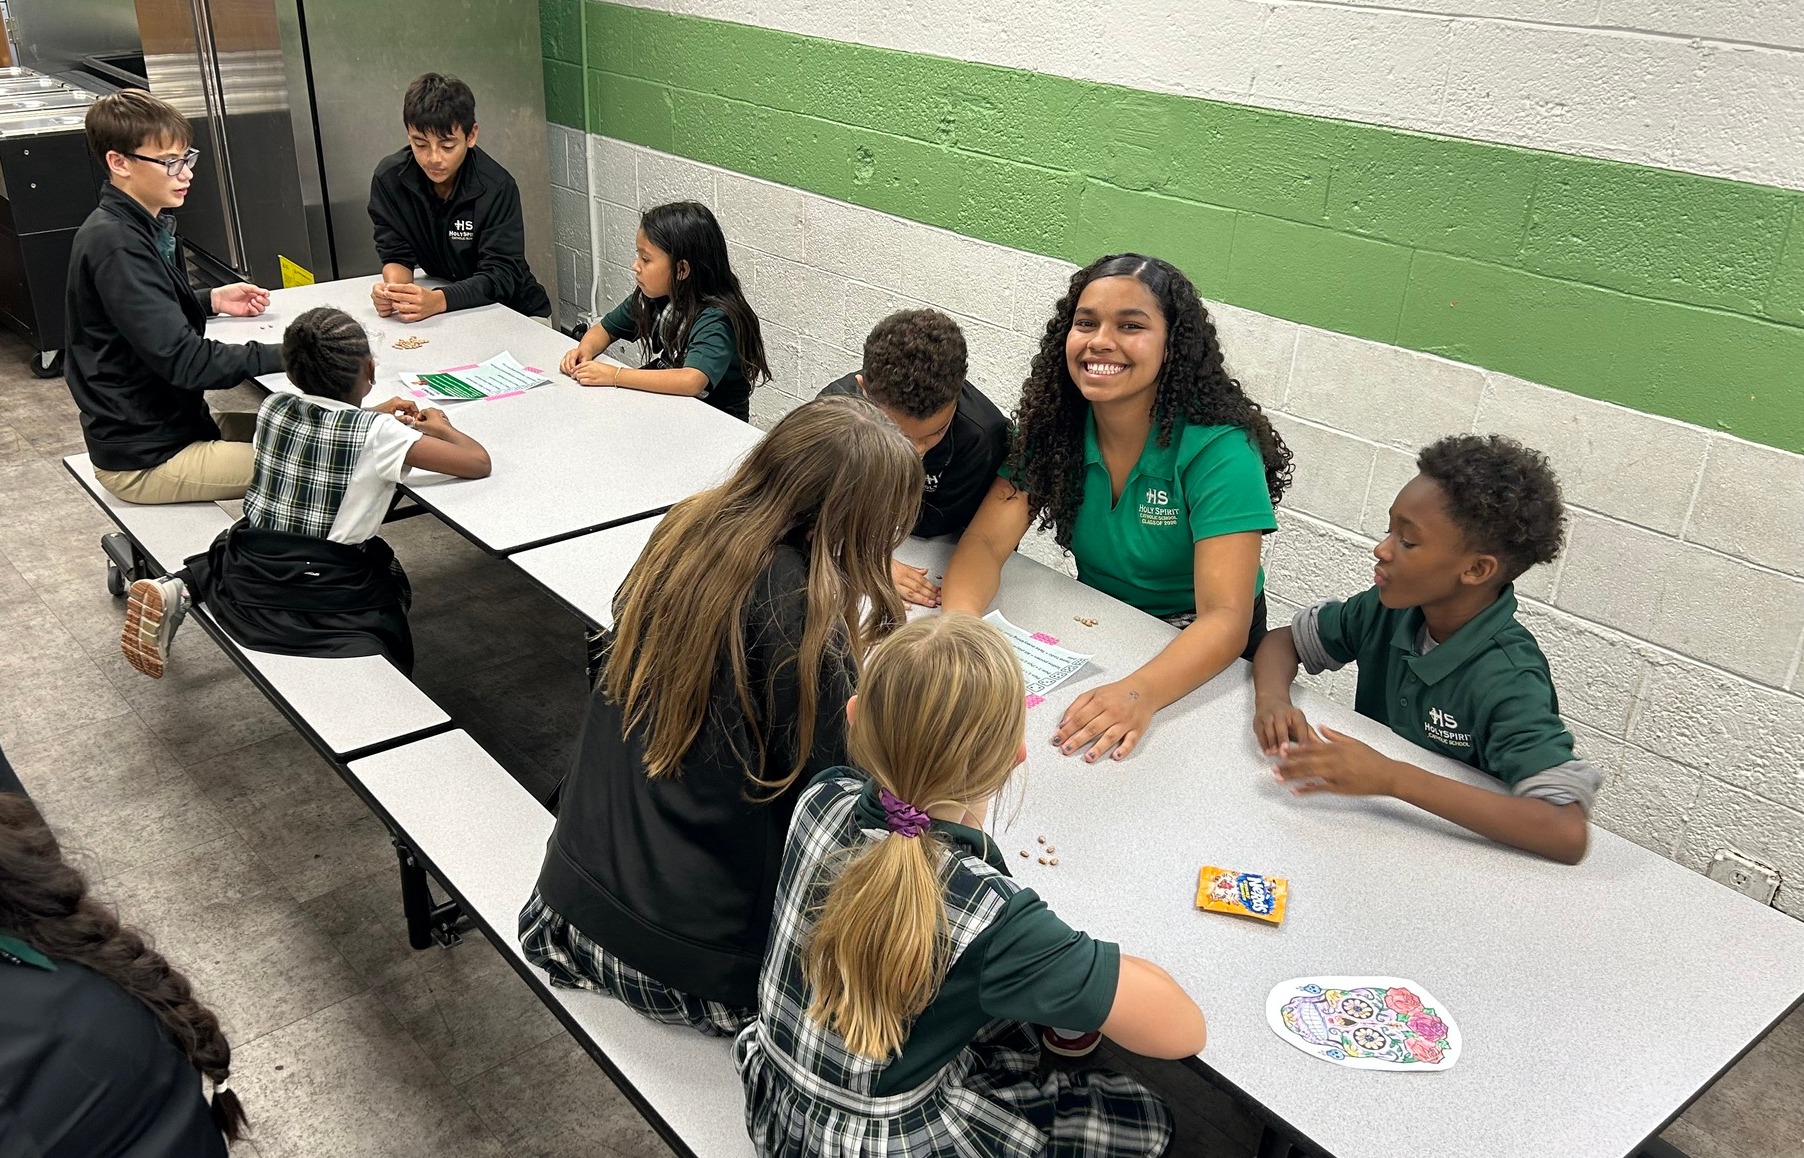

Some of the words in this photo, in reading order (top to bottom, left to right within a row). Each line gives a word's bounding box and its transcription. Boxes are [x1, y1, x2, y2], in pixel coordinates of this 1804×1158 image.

[454, 219, 473, 231] HS
[1146, 488, 1169, 505] HS
[1428, 706, 1459, 729] HS
[1448, 740, 1471, 748] SCHOOL
